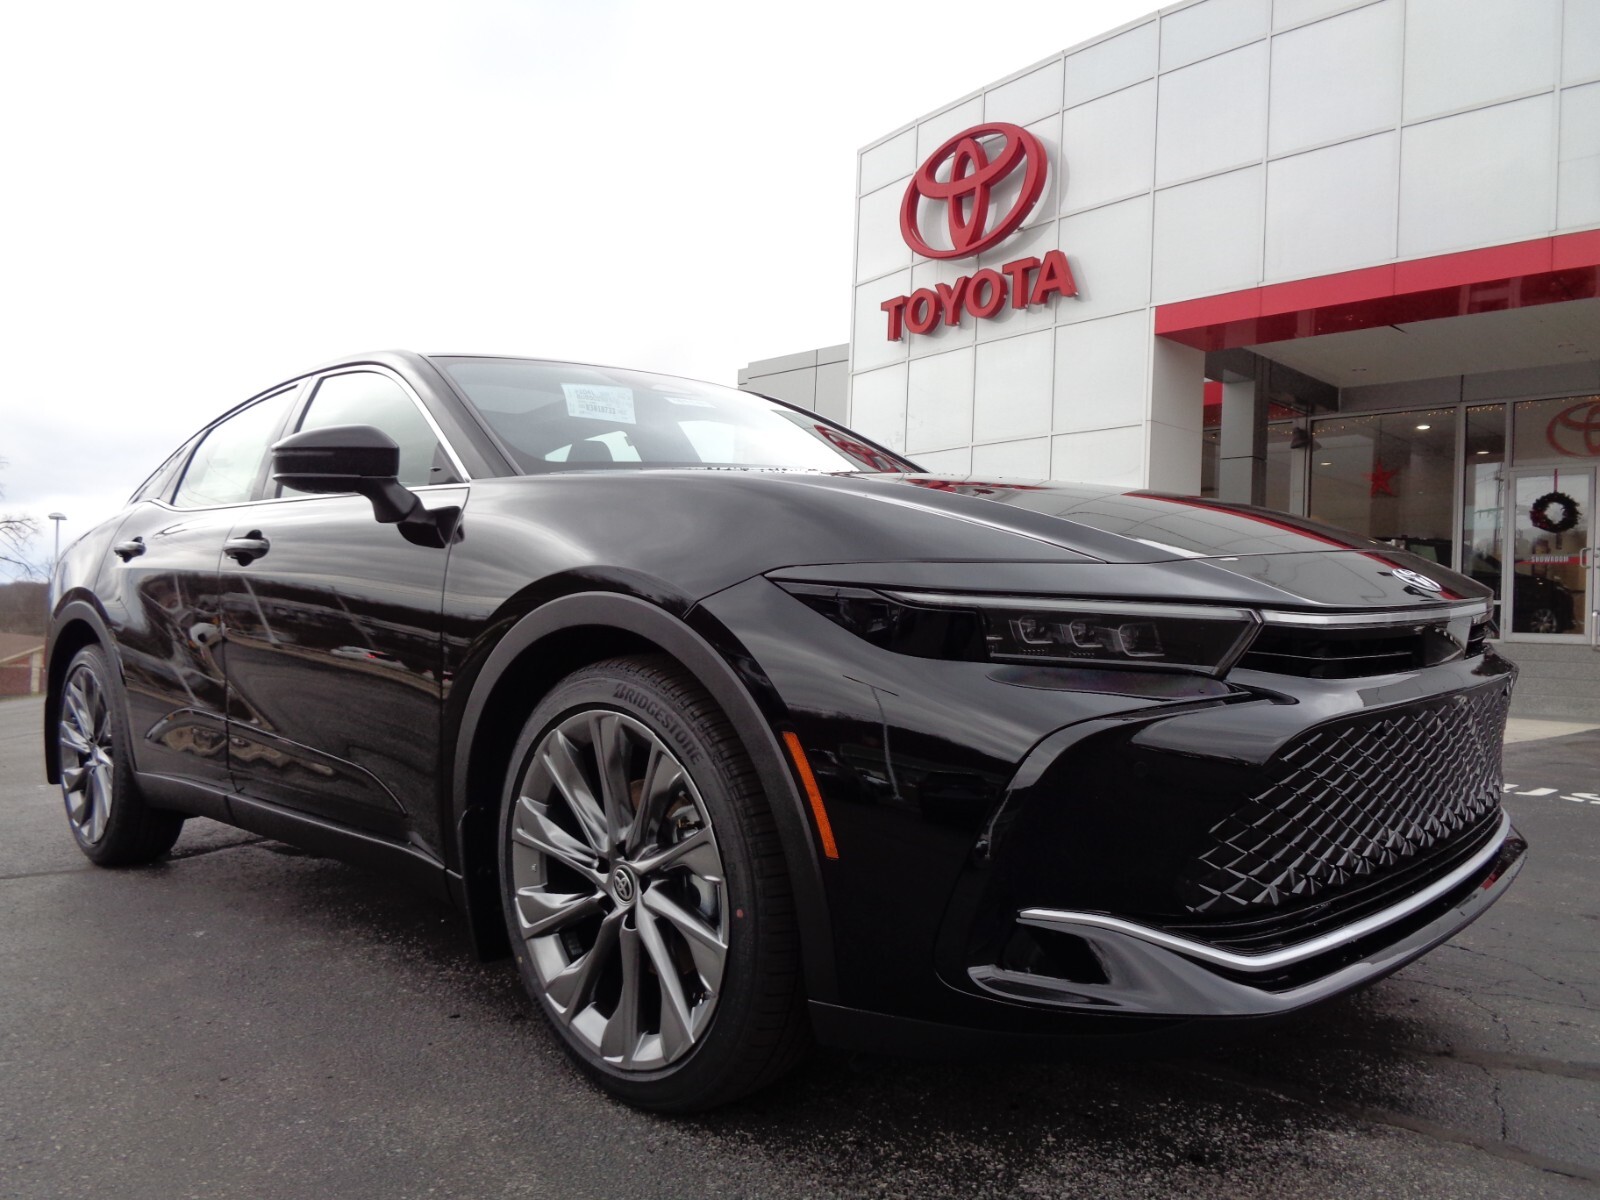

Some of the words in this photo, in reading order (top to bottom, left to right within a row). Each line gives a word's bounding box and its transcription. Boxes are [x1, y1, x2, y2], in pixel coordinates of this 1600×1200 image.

[881, 249, 1077, 341] TOYOTA
[1531, 555, 1569, 563] SHOWROOM
[613, 682, 704, 766] BRIDGESTONE
